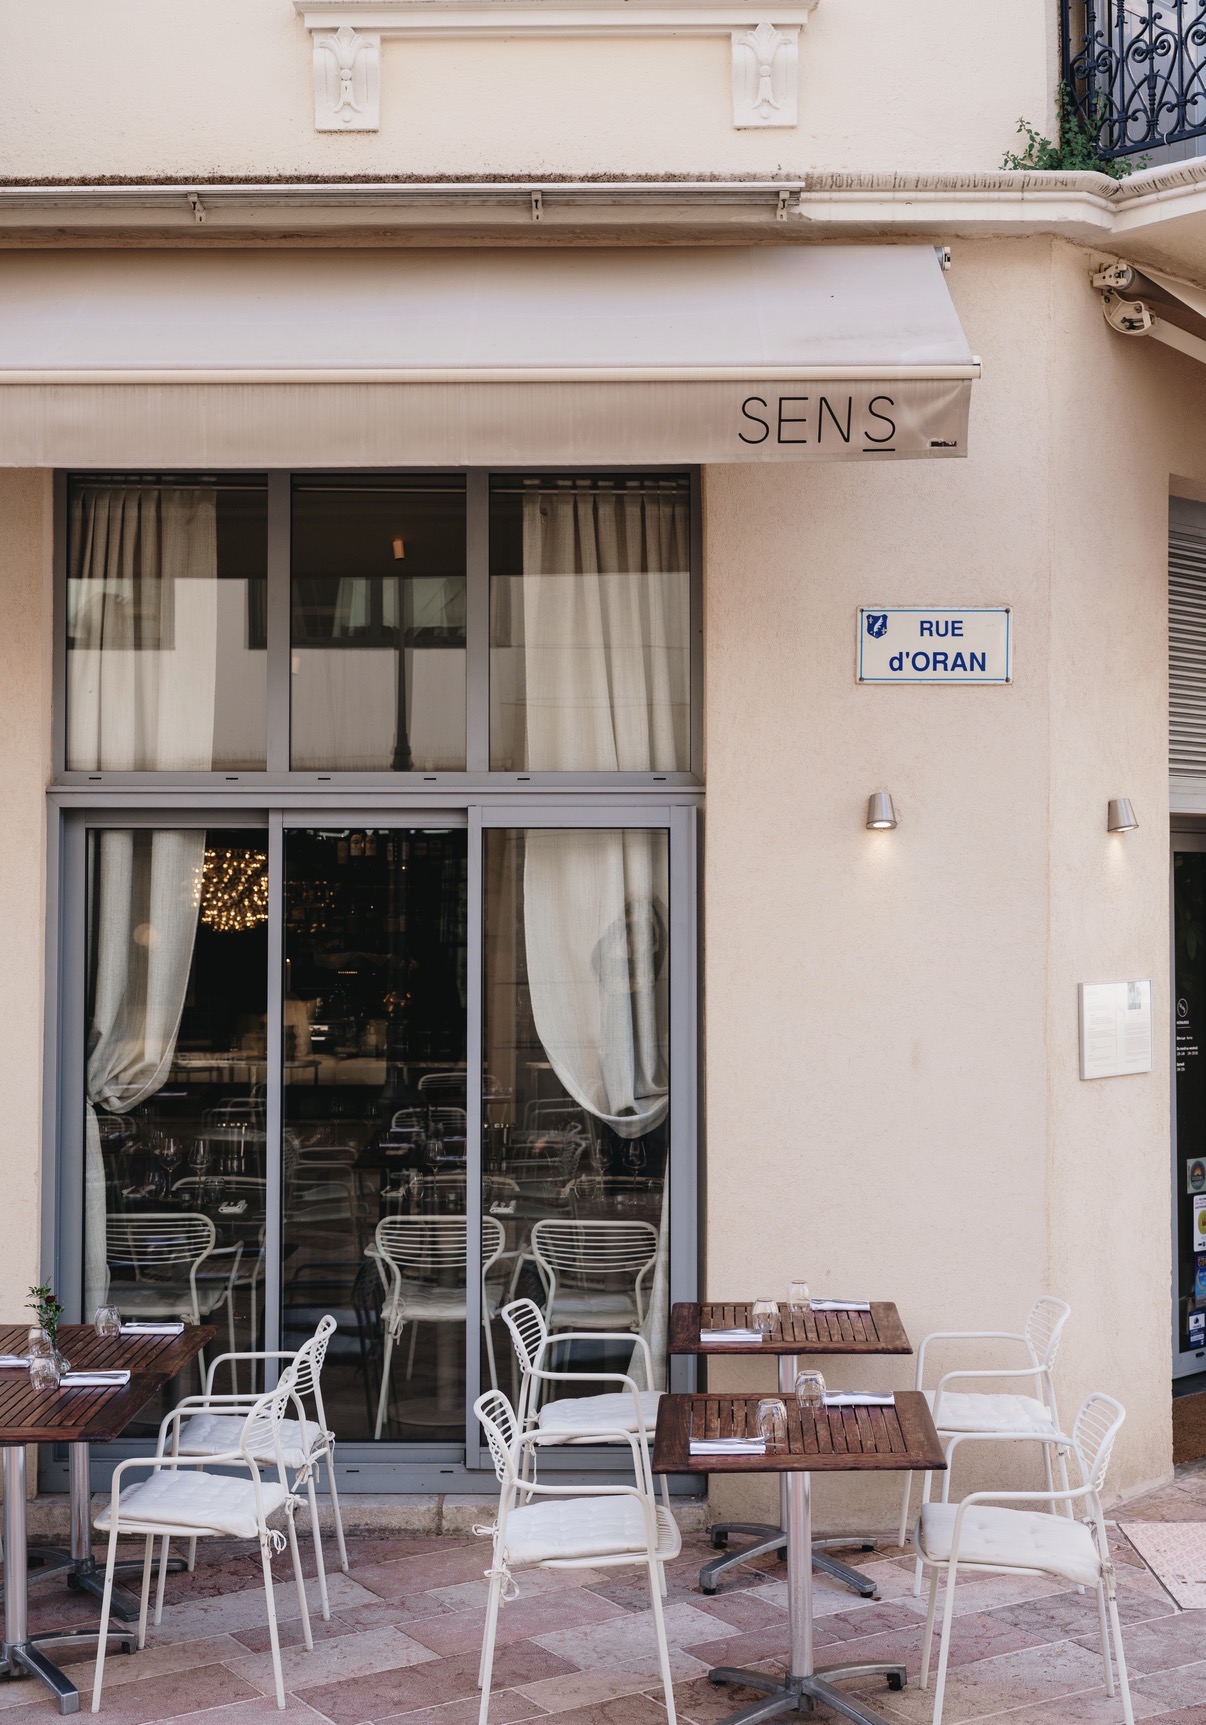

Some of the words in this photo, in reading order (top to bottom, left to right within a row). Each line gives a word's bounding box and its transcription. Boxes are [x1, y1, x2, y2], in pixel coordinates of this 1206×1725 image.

[738, 396, 896, 444] SENS
[919, 620, 964, 637] RUE
[888, 651, 986, 672] d'ORAN
